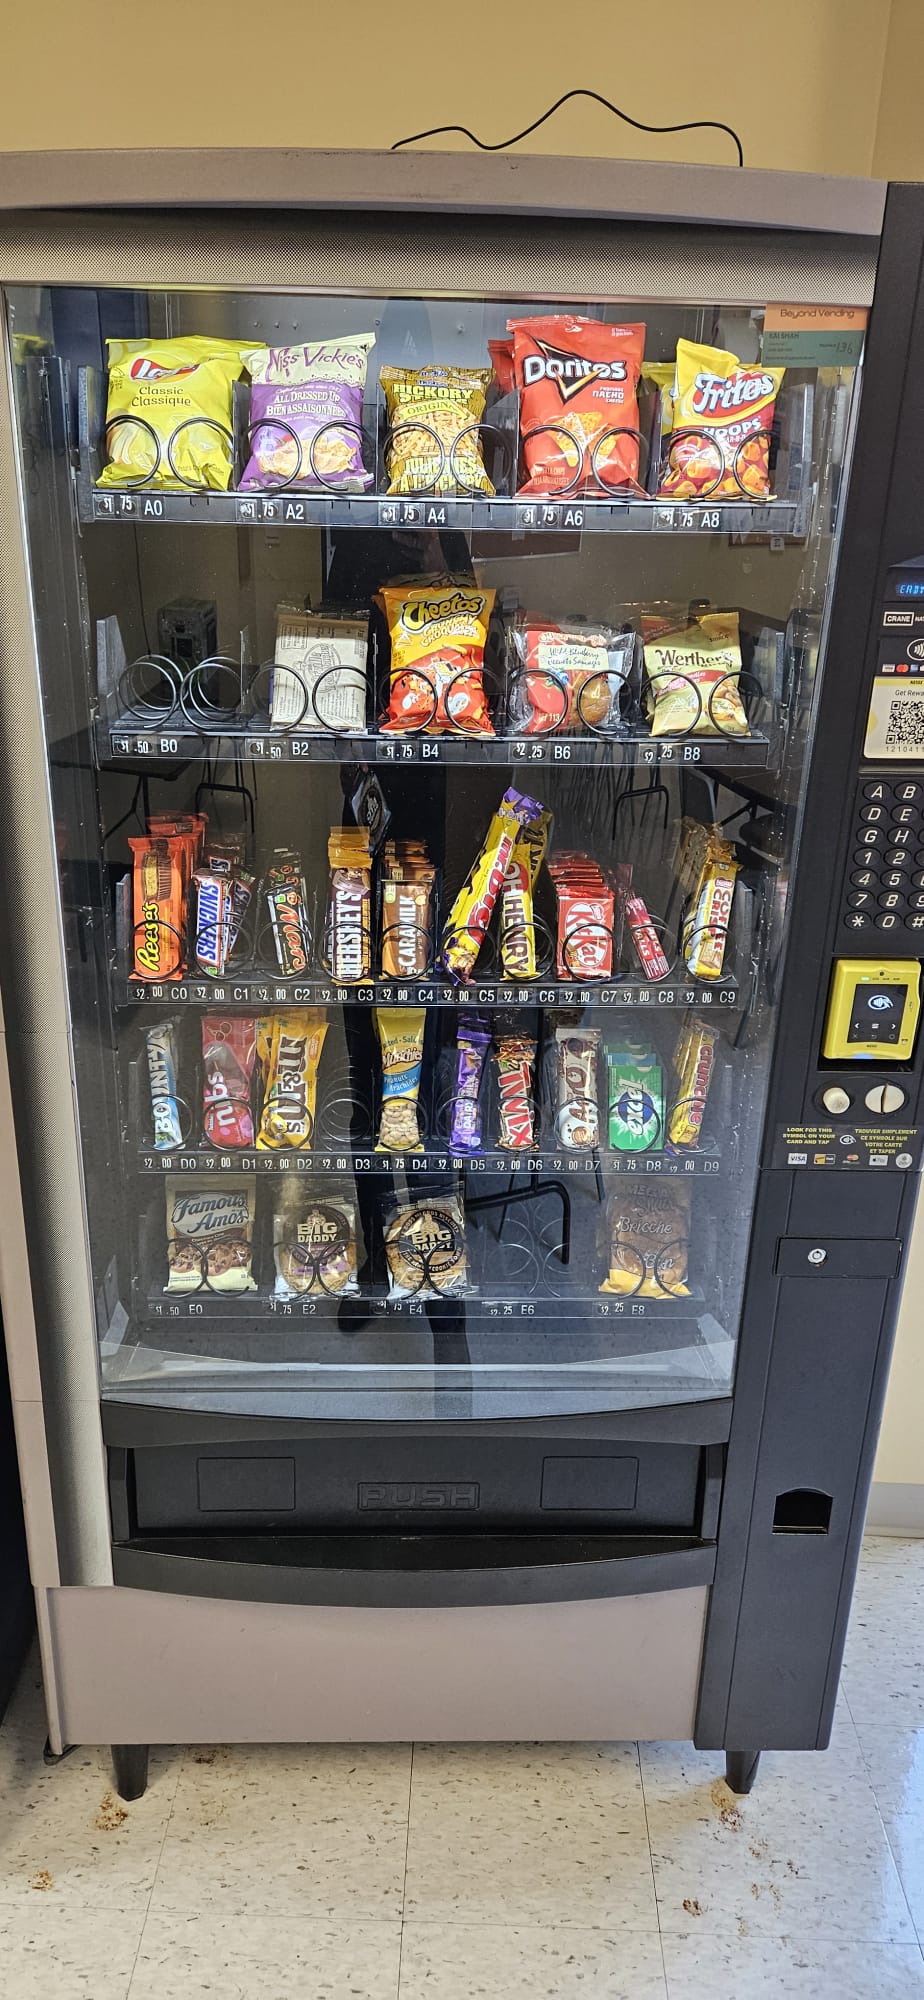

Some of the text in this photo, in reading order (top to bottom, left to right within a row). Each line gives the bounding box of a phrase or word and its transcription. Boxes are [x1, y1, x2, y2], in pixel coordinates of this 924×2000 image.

[780, 308, 855, 320] Beyond Vending
[303, 346, 364, 370] Vickie's
[523, 354, 628, 386] Doritos
[139, 386, 184, 396] Classic
[274, 390, 341, 404] ALL DRESSED UP
[393, 383, 474, 400] HICKORY
[592, 391, 625, 399] NACHO
[692, 372, 774, 414] Fritos
[131, 396, 191, 407] Classique
[703, 417, 761, 439] HOOPS
[144, 502, 163, 516] A0
[285, 503, 304, 520] A2
[427, 508, 446, 524] A4
[564, 509, 583, 526] A6
[701, 511, 720, 528] A8
[402, 592, 482, 631] Cheetos
[894, 689, 906, 697] Get
[160, 738, 178, 753] B0
[292, 741, 309, 756] B2
[422, 743, 439, 758] B4
[554, 745, 571, 759] B6
[683, 746, 701, 761] B8
[870, 785, 917, 799] A B
[867, 807, 913, 821] D E
[864, 830, 910, 843] G H
[864, 852, 906, 865] 1 2
[858, 873, 902, 886] 4 5
[855, 894, 899, 907] 7 8
[196, 878, 220, 962] SNICKERS
[503, 861, 529, 973] OH HENRY
[708, 889, 722, 938] CRISP
[136, 901, 160, 971] Reese's
[276, 904, 306, 970] Mars
[336, 890, 362, 979] HERSHEY'S
[398, 895, 416, 968] CARAMILK
[171, 986, 188, 1000] C0
[233, 988, 249, 1001] C1
[294, 988, 311, 1001] C2
[357, 988, 374, 1001] C3
[418, 988, 434, 1002] C4
[479, 988, 495, 1002] C5
[539, 990, 555, 1003] C6
[601, 990, 617, 1003] C7
[658, 990, 674, 1003] C8
[719, 991, 736, 1003] C9
[382, 1046, 423, 1070] Munchies
[147, 1044, 173, 1133] BOUNTY
[205, 1071, 237, 1127] nibs
[498, 1061, 533, 1145] TWIX
[180, 1158, 197, 1169] D0
[242, 1159, 257, 1170] D1
[297, 1158, 313, 1170] D2
[355, 1159, 371, 1170] D3
[412, 1159, 428, 1170] D4
[470, 1160, 486, 1171] D5
[527, 1160, 543, 1171] D6
[584, 1160, 601, 1171] D7
[646, 1160, 662, 1172] D8
[703, 1161, 720, 1172] D9
[171, 1194, 246, 1224] Famous
[187, 1209, 249, 1234] Amos
[297, 1222, 338, 1235] BIG
[297, 1234, 337, 1243] DADDY
[411, 1229, 452, 1245] BIG
[188, 1304, 203, 1316] E0
[302, 1304, 316, 1315] E2
[409, 1304, 423, 1315] E4
[521, 1304, 535, 1316] E6
[631, 1304, 645, 1316] E8
[361, 1484, 478, 1508] PUSH
